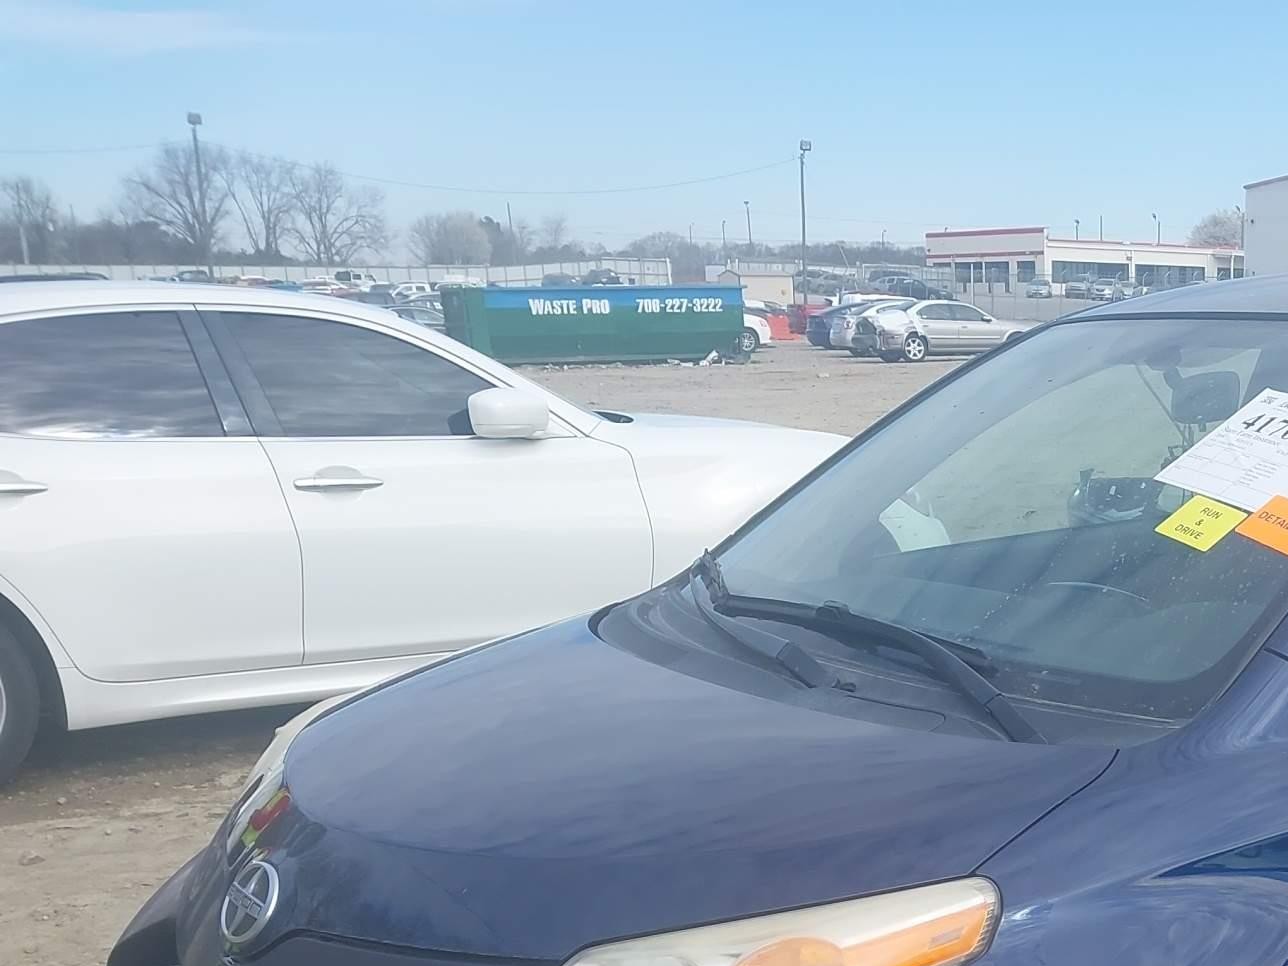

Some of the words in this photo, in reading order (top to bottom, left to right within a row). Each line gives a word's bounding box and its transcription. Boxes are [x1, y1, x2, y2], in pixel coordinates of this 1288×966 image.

[582, 299, 610, 314] PRO
[1200, 507, 1222, 520] RUN
[1174, 523, 1205, 540] DRIVE
